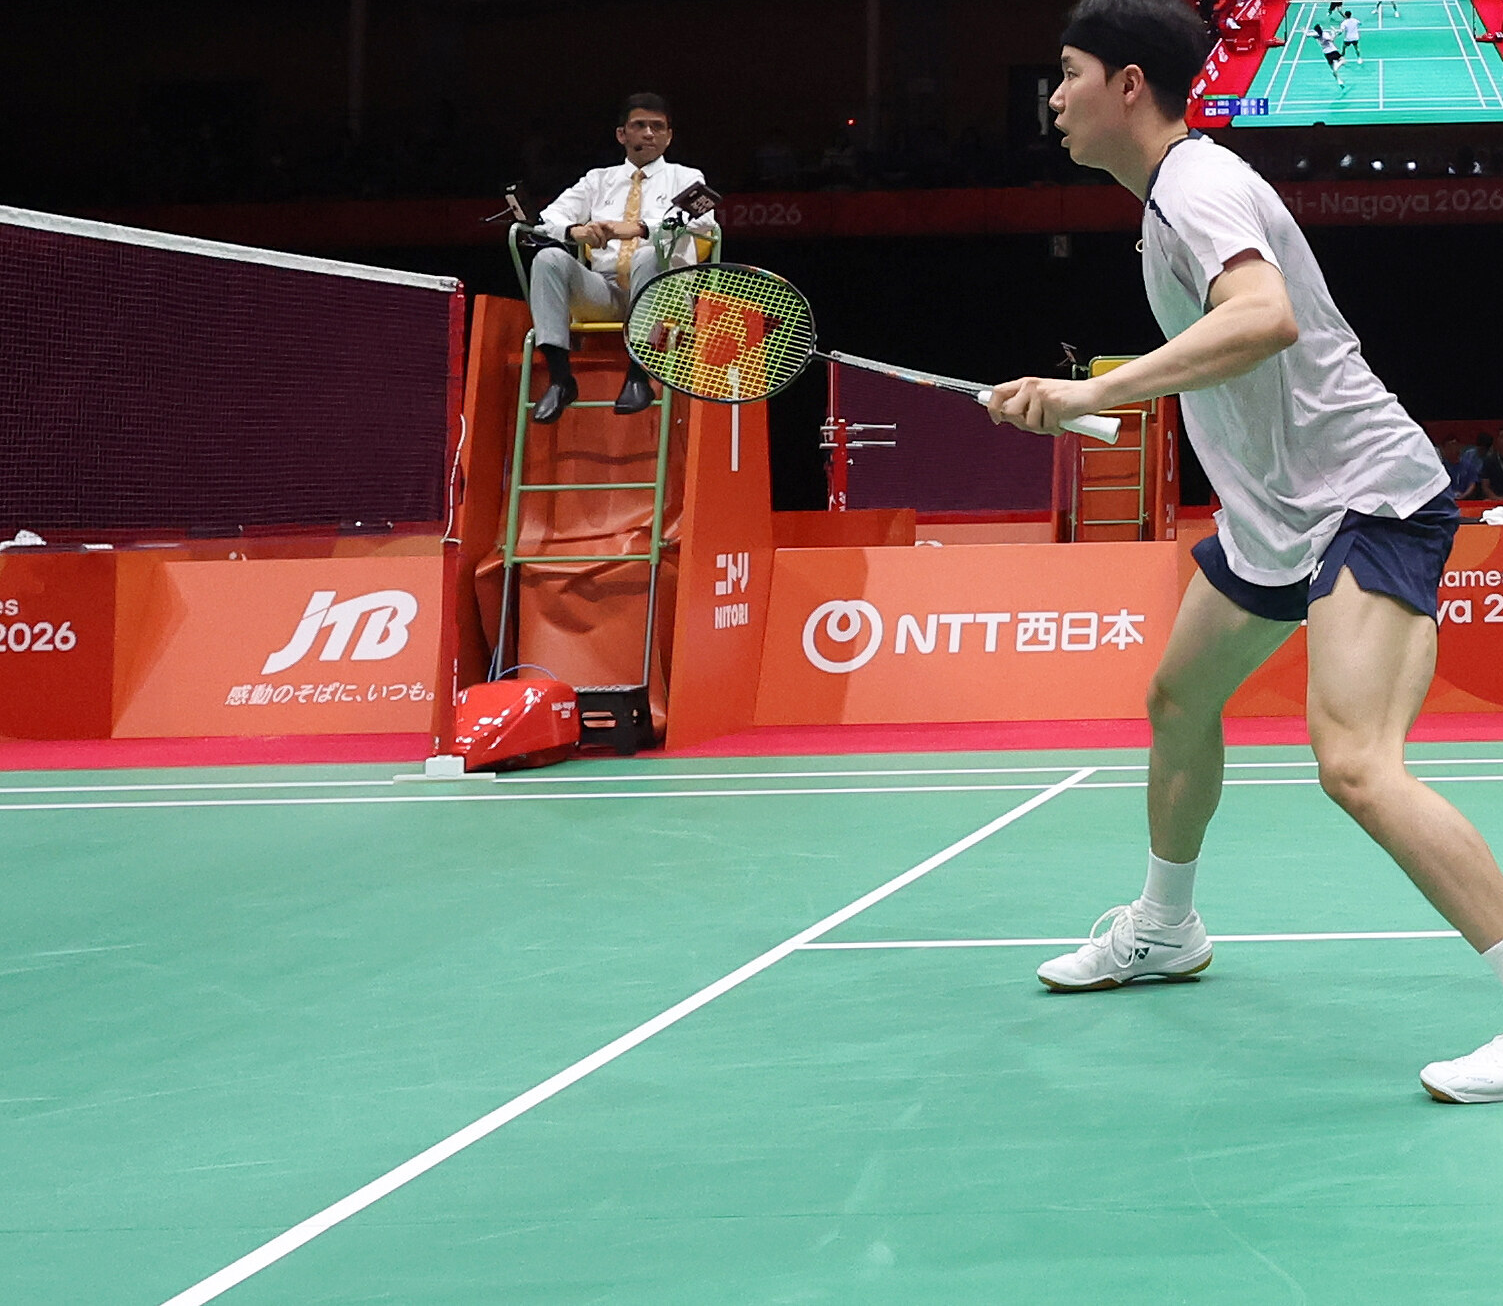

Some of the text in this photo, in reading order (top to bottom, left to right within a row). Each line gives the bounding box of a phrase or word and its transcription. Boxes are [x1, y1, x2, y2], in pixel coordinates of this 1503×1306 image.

[731, 203, 802, 227] 2026
[714, 602, 749, 630] NITORI
[260, 589, 419, 676] JTB
